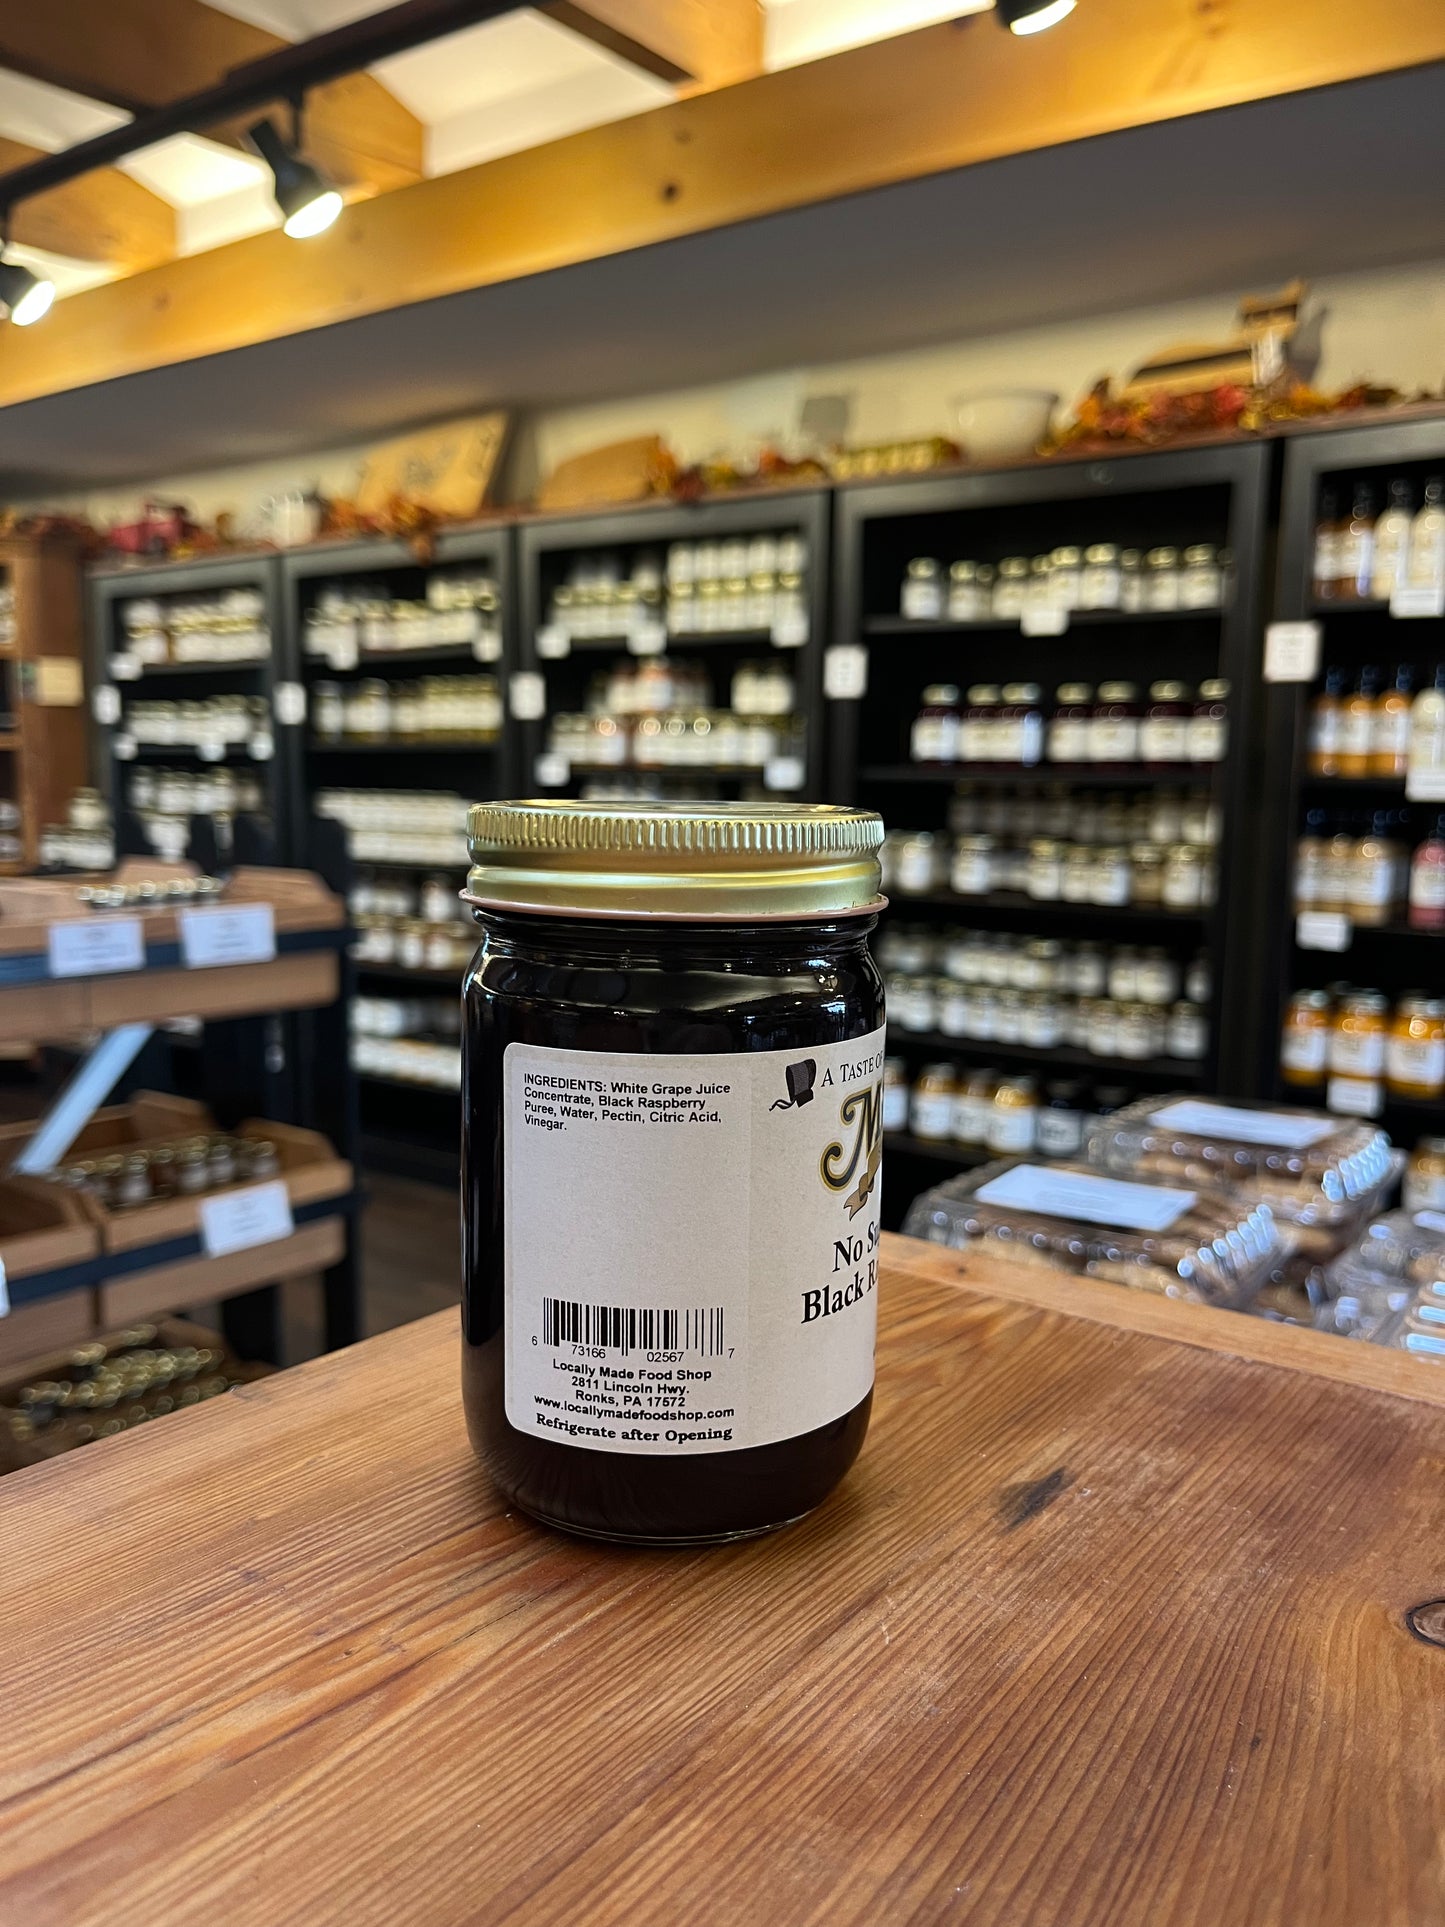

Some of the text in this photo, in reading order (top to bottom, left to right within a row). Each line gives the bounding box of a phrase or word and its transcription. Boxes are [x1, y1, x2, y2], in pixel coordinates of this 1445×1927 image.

[524, 1073, 731, 1096] INGREDIENTS: White Grape Juice
[821, 1067, 834, 1087] A
[524, 1087, 706, 1111] Concentrate, Black Raspberry
[524, 1102, 722, 1124] Puree, Water, Pectin, Citric Acid,
[524, 1115, 567, 1131] Vinegar.
[832, 1235, 863, 1273] No
[801, 1258, 878, 1324] Black R
[531, 1335, 735, 1363] 6 73166 02567 7
[553, 1358, 712, 1382] Locally Made Food Shop
[571, 1376, 690, 1396] 2811 Lincoln Hwy.
[534, 1394, 735, 1422] www.locallymadefoodshop.com
[575, 1390, 686, 1407] Ronks, PA 17572
[536, 1413, 733, 1444] Refrigerate after Opening
